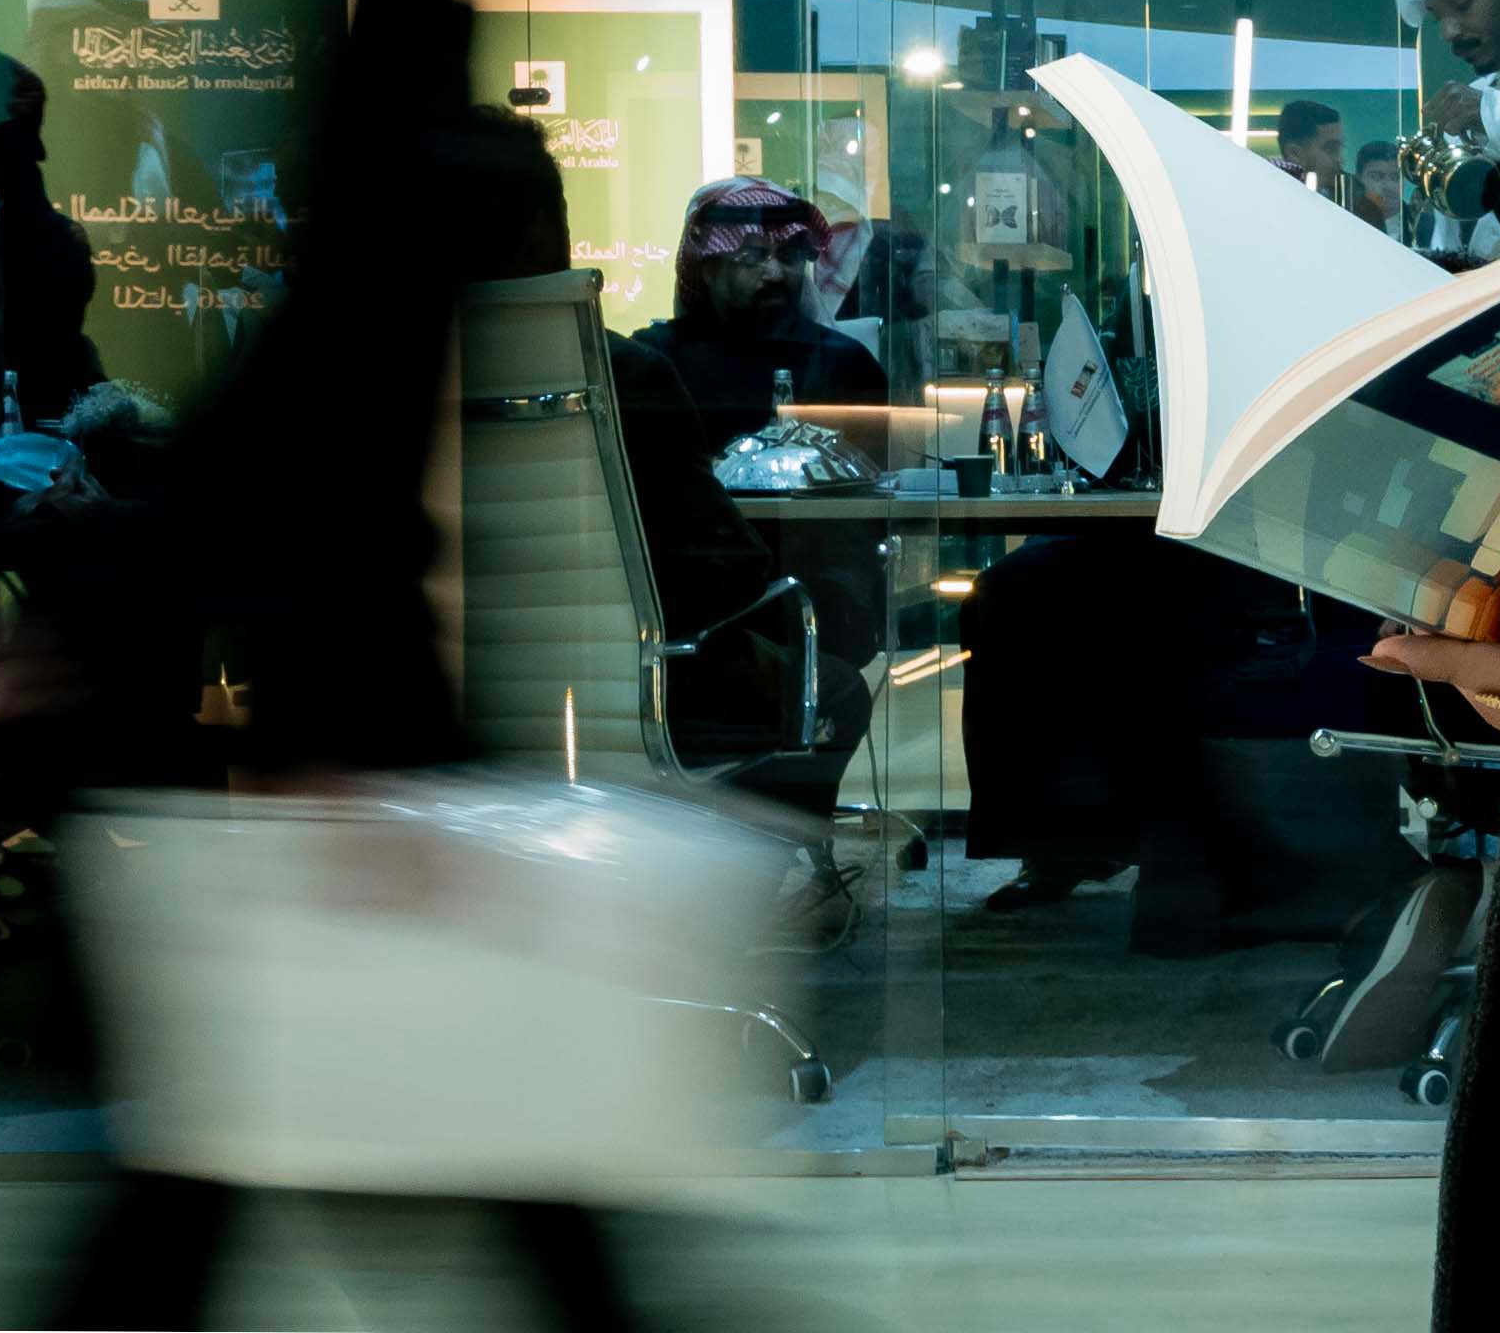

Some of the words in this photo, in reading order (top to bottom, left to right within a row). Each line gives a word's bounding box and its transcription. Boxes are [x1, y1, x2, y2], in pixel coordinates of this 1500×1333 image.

[578, 156, 620, 169] Arabia
[570, 240, 626, 262] المملك
[630, 241, 671, 268] جناح
[624, 274, 643, 302] في
